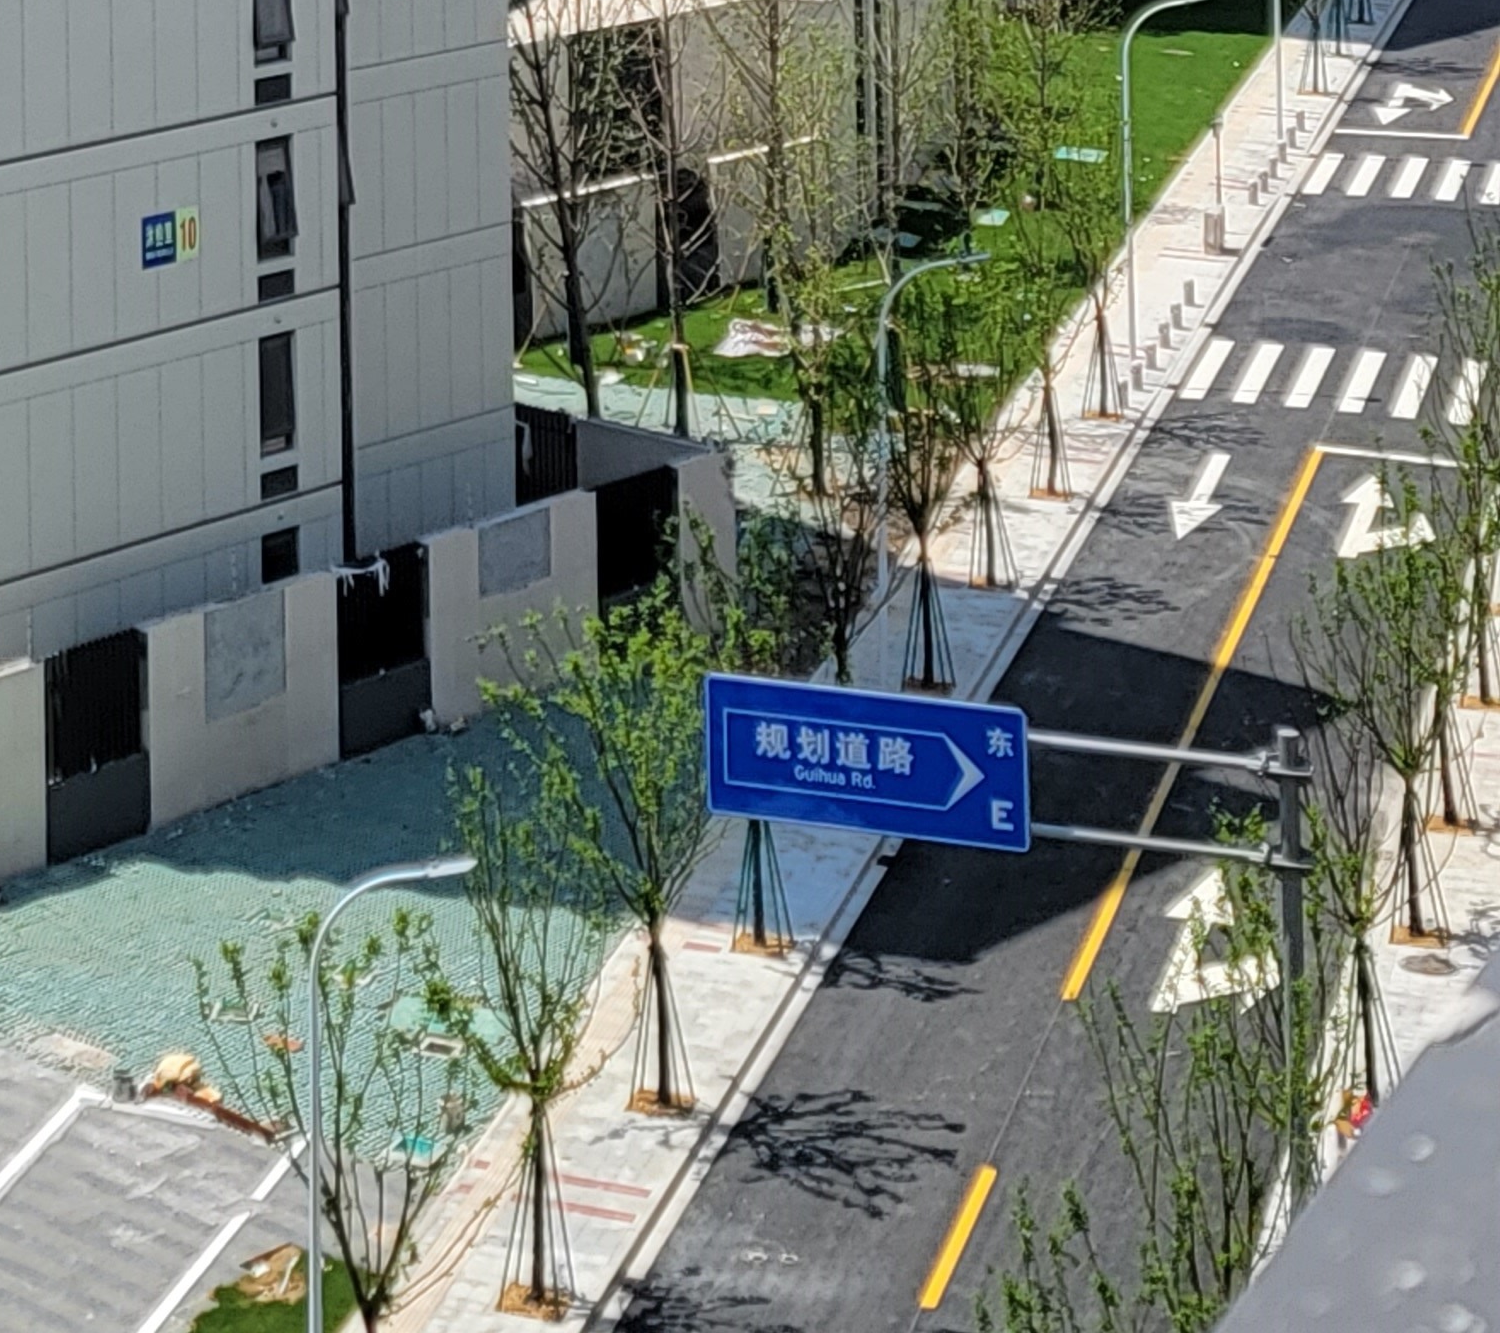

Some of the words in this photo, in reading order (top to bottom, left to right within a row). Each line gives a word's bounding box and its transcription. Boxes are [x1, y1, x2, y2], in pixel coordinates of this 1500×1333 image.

[180, 216, 197, 252] 10
[756, 721, 914, 775] 规划道路
[986, 727, 1014, 757] 东
[794, 764, 846, 786] Guihua
[851, 771, 876, 789] Rd.
[992, 800, 1014, 831] E
